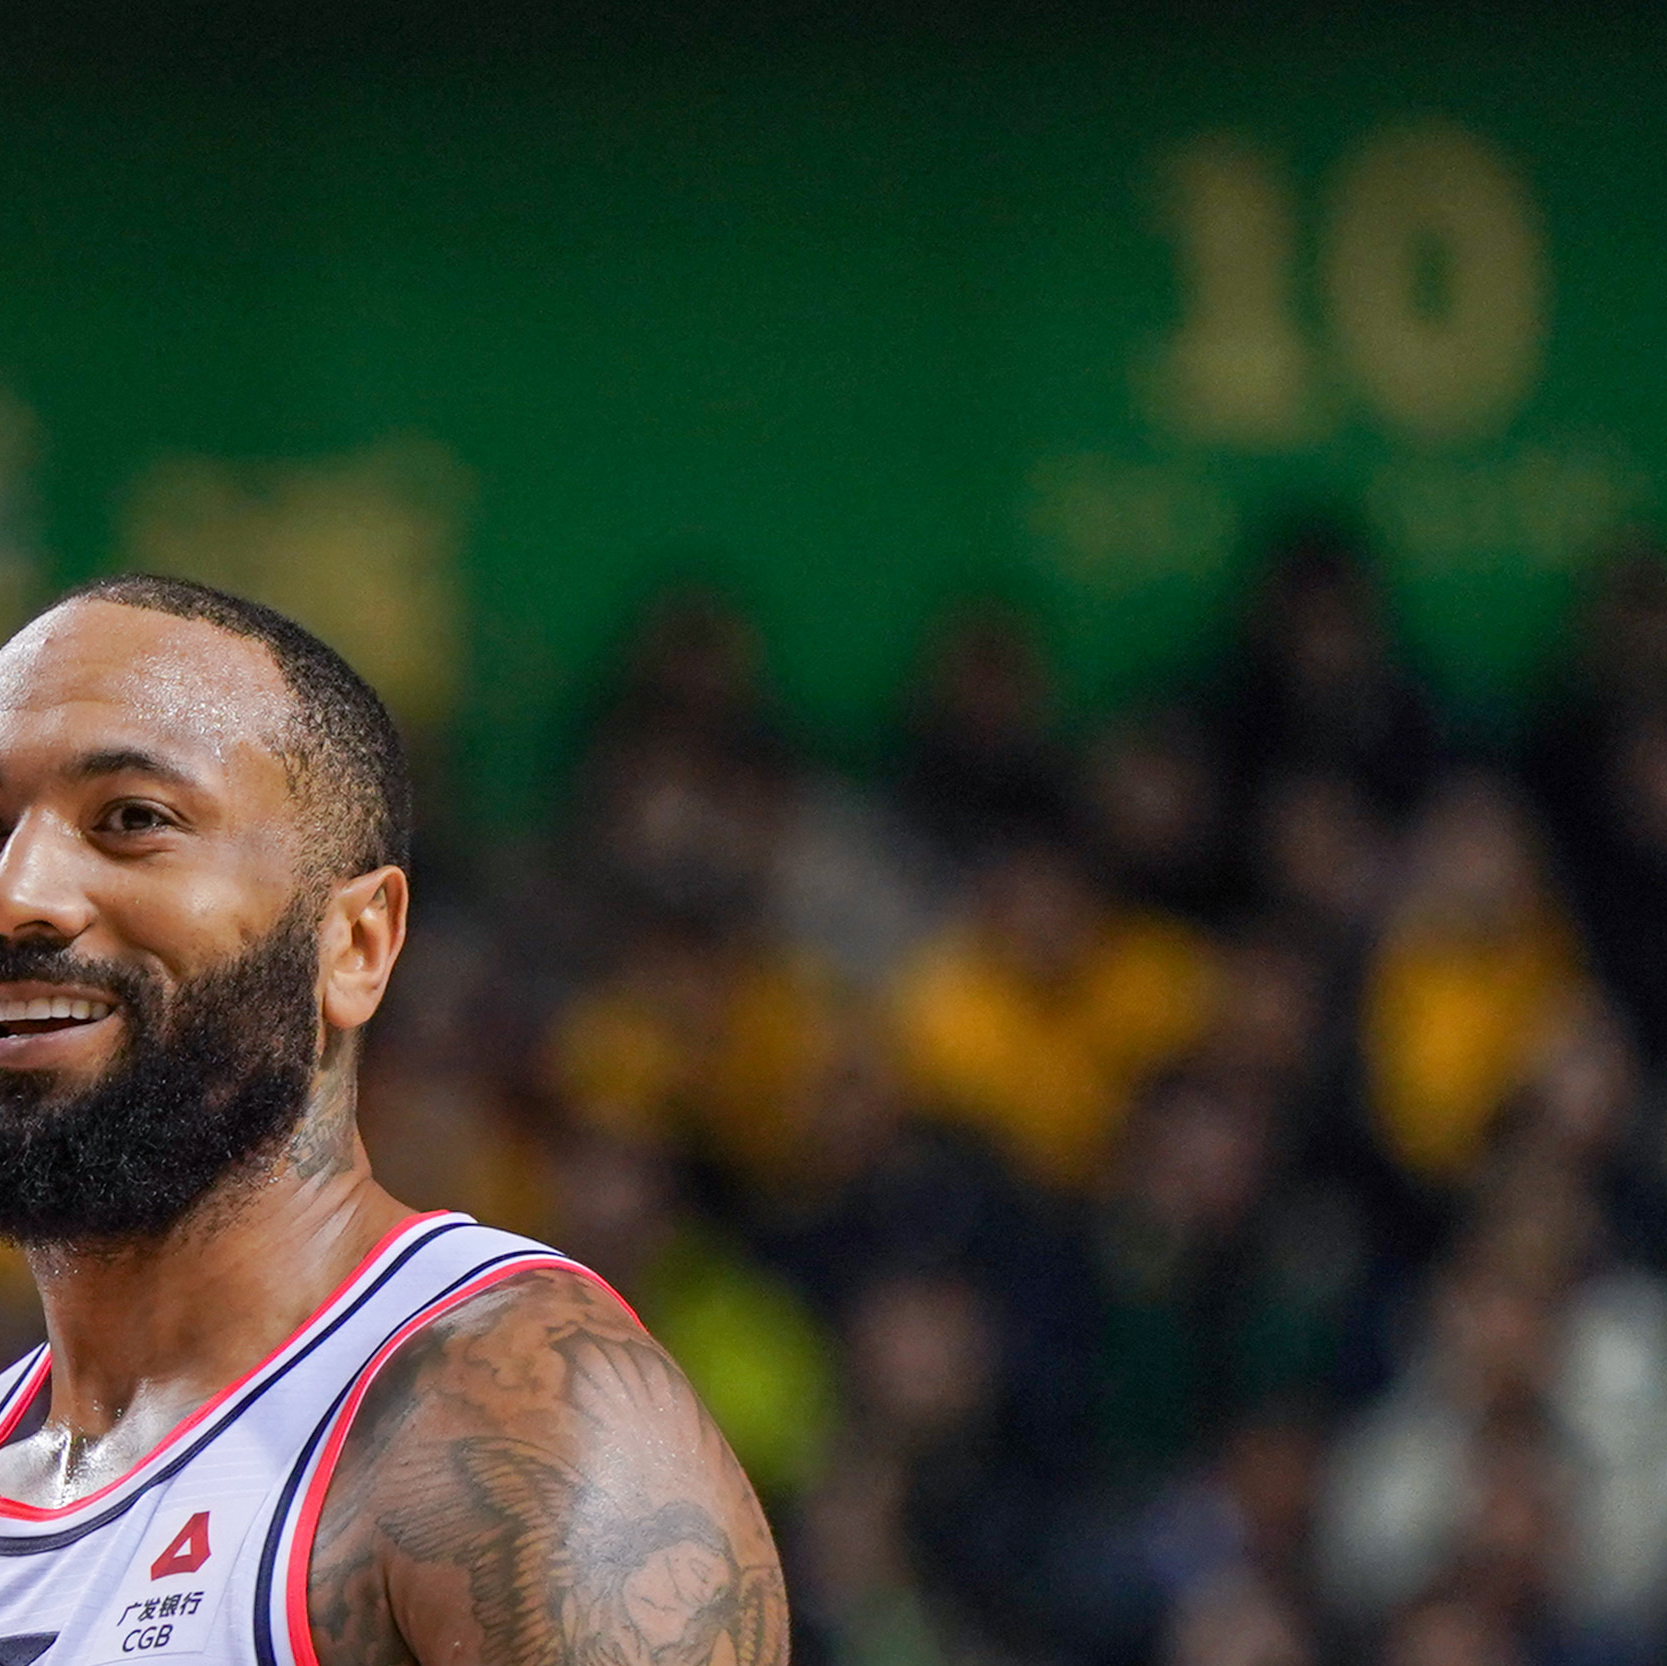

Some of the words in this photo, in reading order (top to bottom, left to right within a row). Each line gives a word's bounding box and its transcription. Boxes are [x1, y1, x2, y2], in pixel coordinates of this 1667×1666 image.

[117, 1591, 204, 1626] 广发银行
[122, 1624, 174, 1652] CGB
